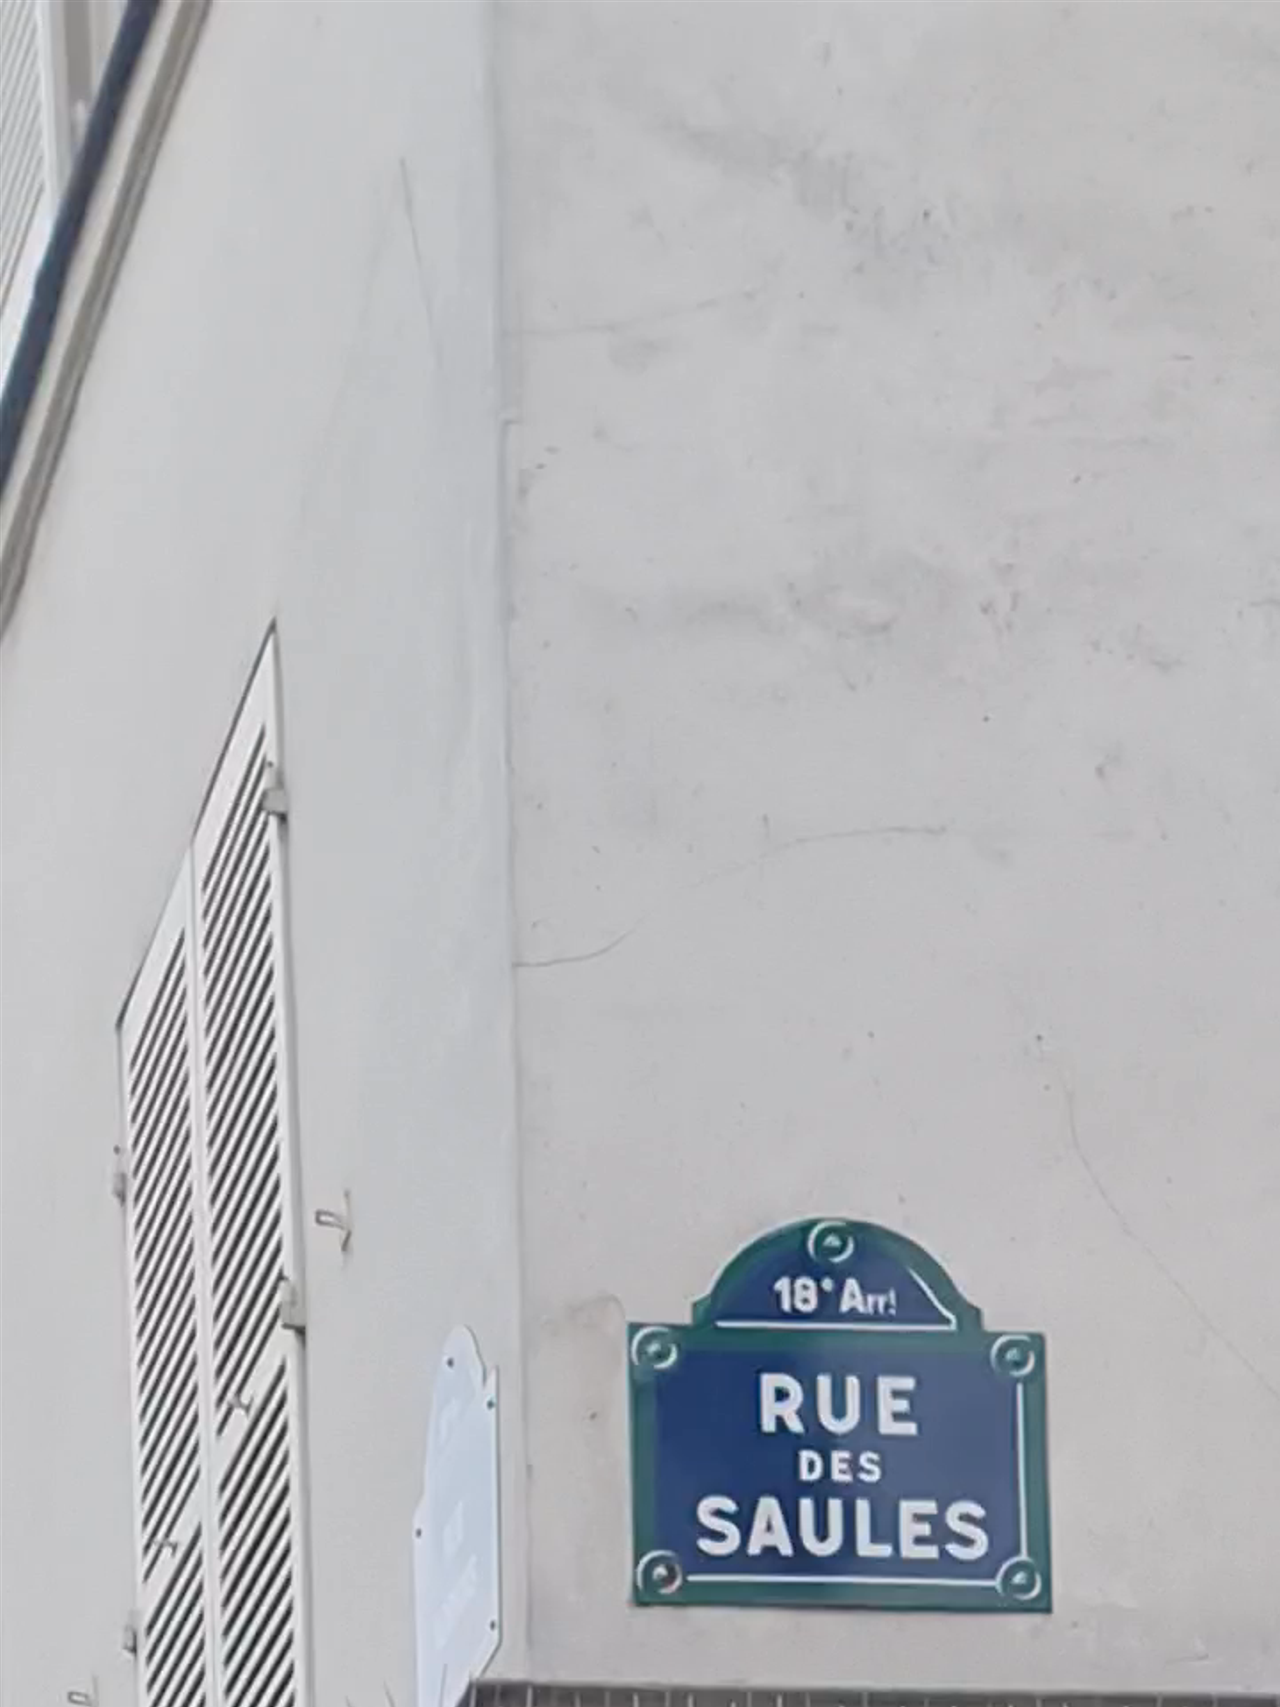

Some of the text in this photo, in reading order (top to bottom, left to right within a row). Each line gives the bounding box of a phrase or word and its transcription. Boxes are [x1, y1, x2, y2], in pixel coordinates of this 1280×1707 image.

[759, 1372, 918, 1436] RUE
[798, 1450, 882, 1483] DES
[696, 1494, 990, 1561] SAULES
